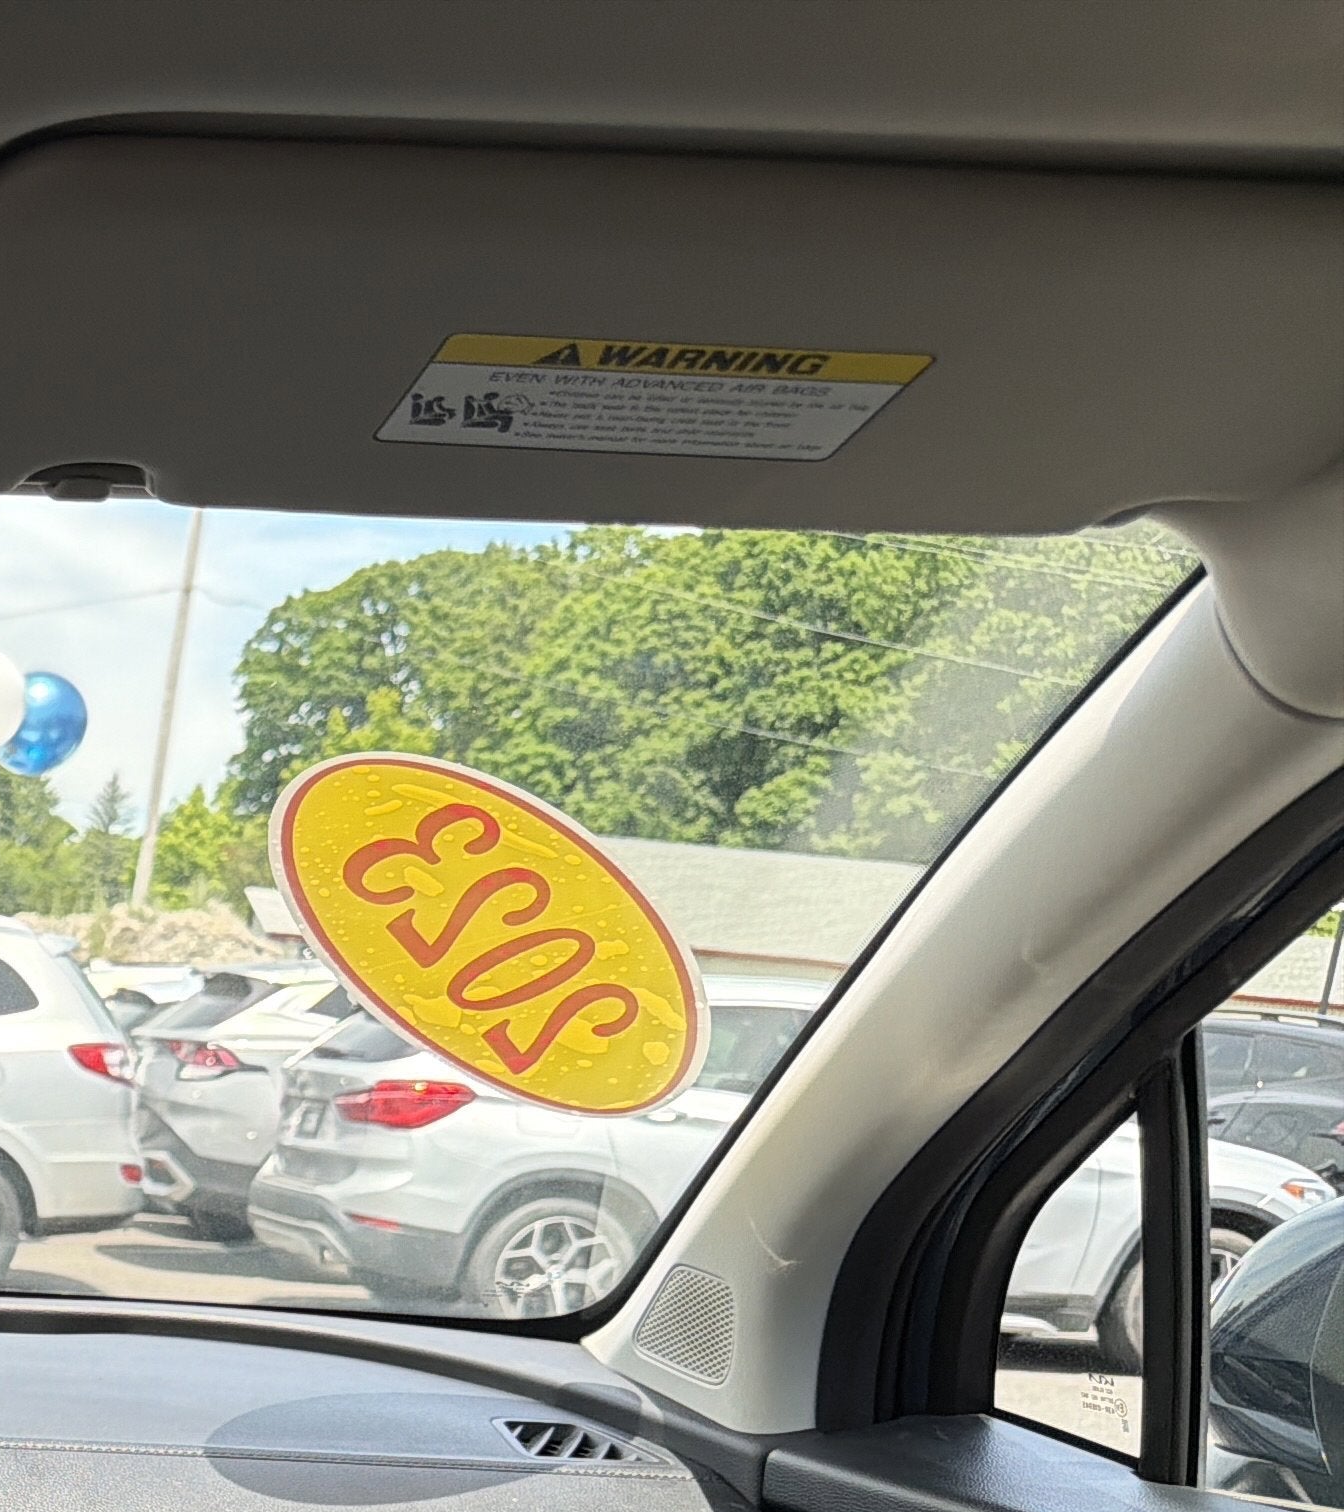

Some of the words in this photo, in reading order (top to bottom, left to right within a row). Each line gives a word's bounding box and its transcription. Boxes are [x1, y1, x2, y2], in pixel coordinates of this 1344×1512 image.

[598, 344, 831, 375] WARNING
[489, 370, 547, 385] EVEN
[554, 373, 606, 387] WITH
[611, 375, 724, 393] ADVANCED
[731, 380, 768, 395] AIR
[771, 382, 834, 398] BAGS
